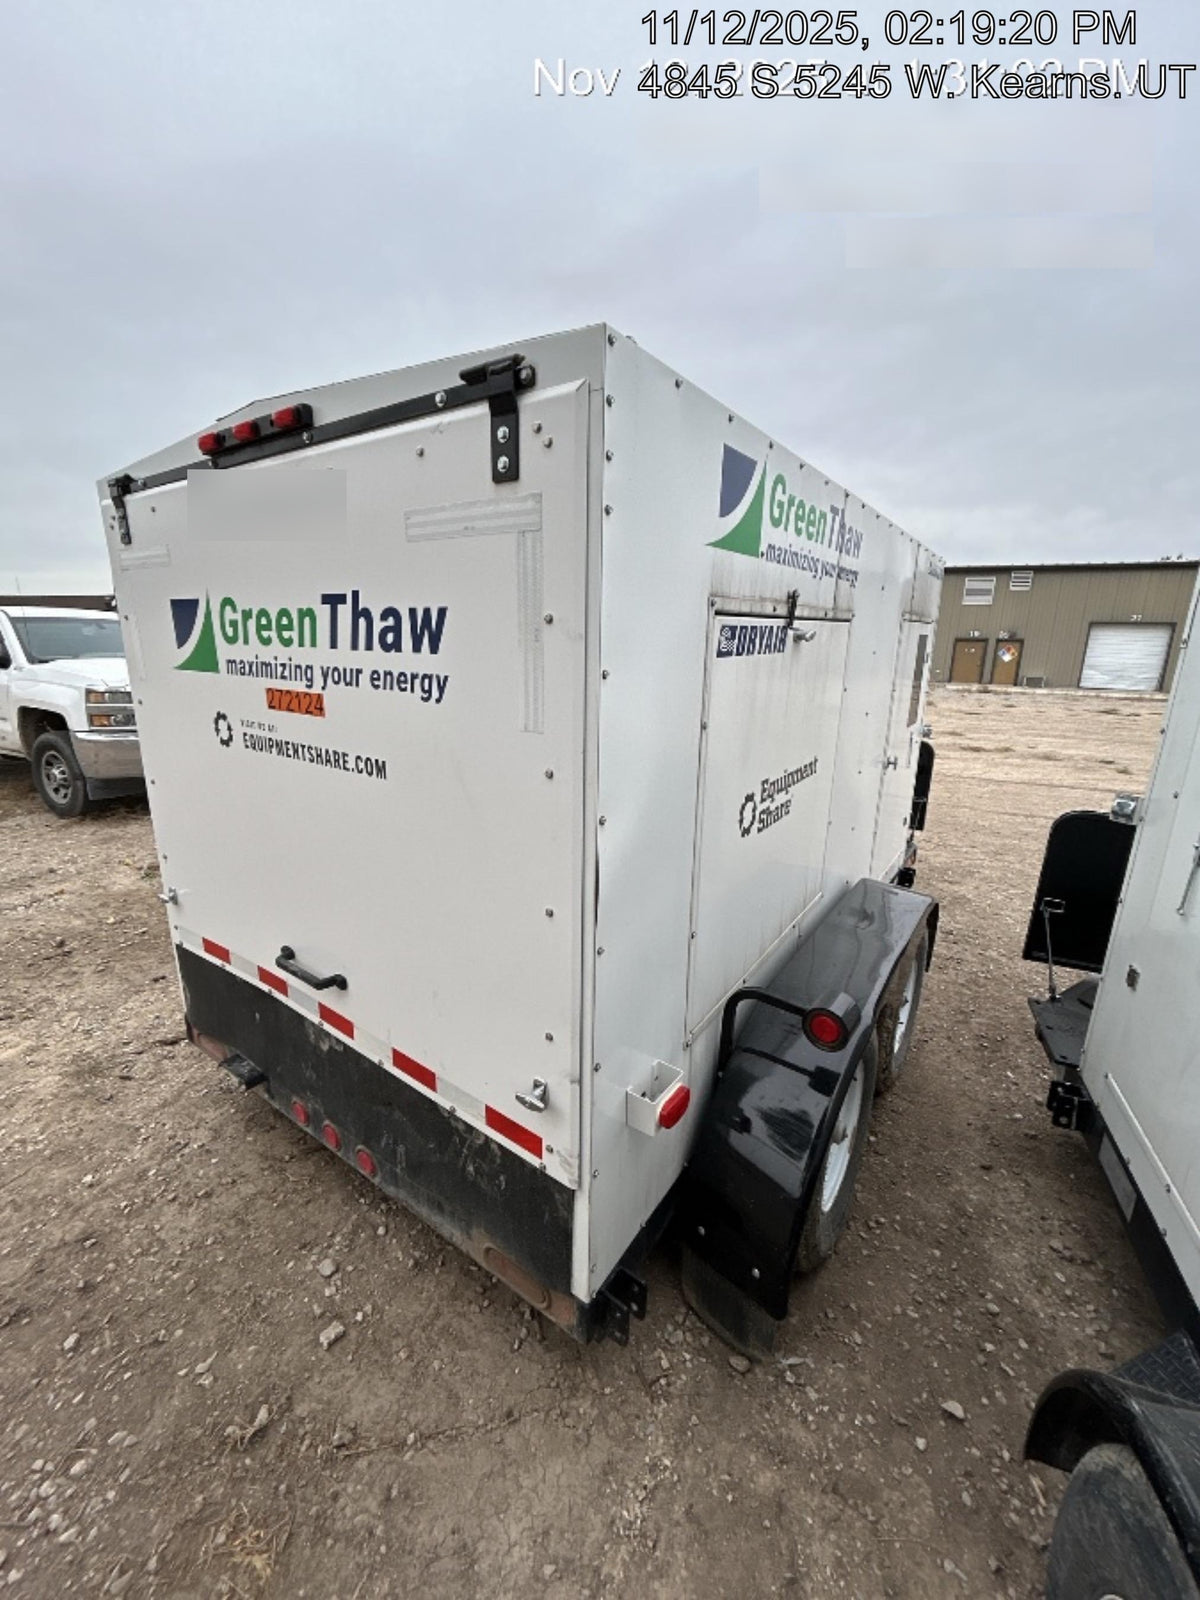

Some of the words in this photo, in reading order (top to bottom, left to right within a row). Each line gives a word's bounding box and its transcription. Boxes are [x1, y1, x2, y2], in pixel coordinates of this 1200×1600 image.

[219, 590, 448, 655] GreenThaw
[735, 624, 789, 657] DRYAIR
[225, 654, 314, 689] maximizing
[321, 665, 364, 690] your
[369, 668, 449, 704] energy
[266, 688, 324, 717] 272124
[242, 731, 387, 780] EQUIPMENTSHARE.COM
[757, 798, 792, 834] Share
